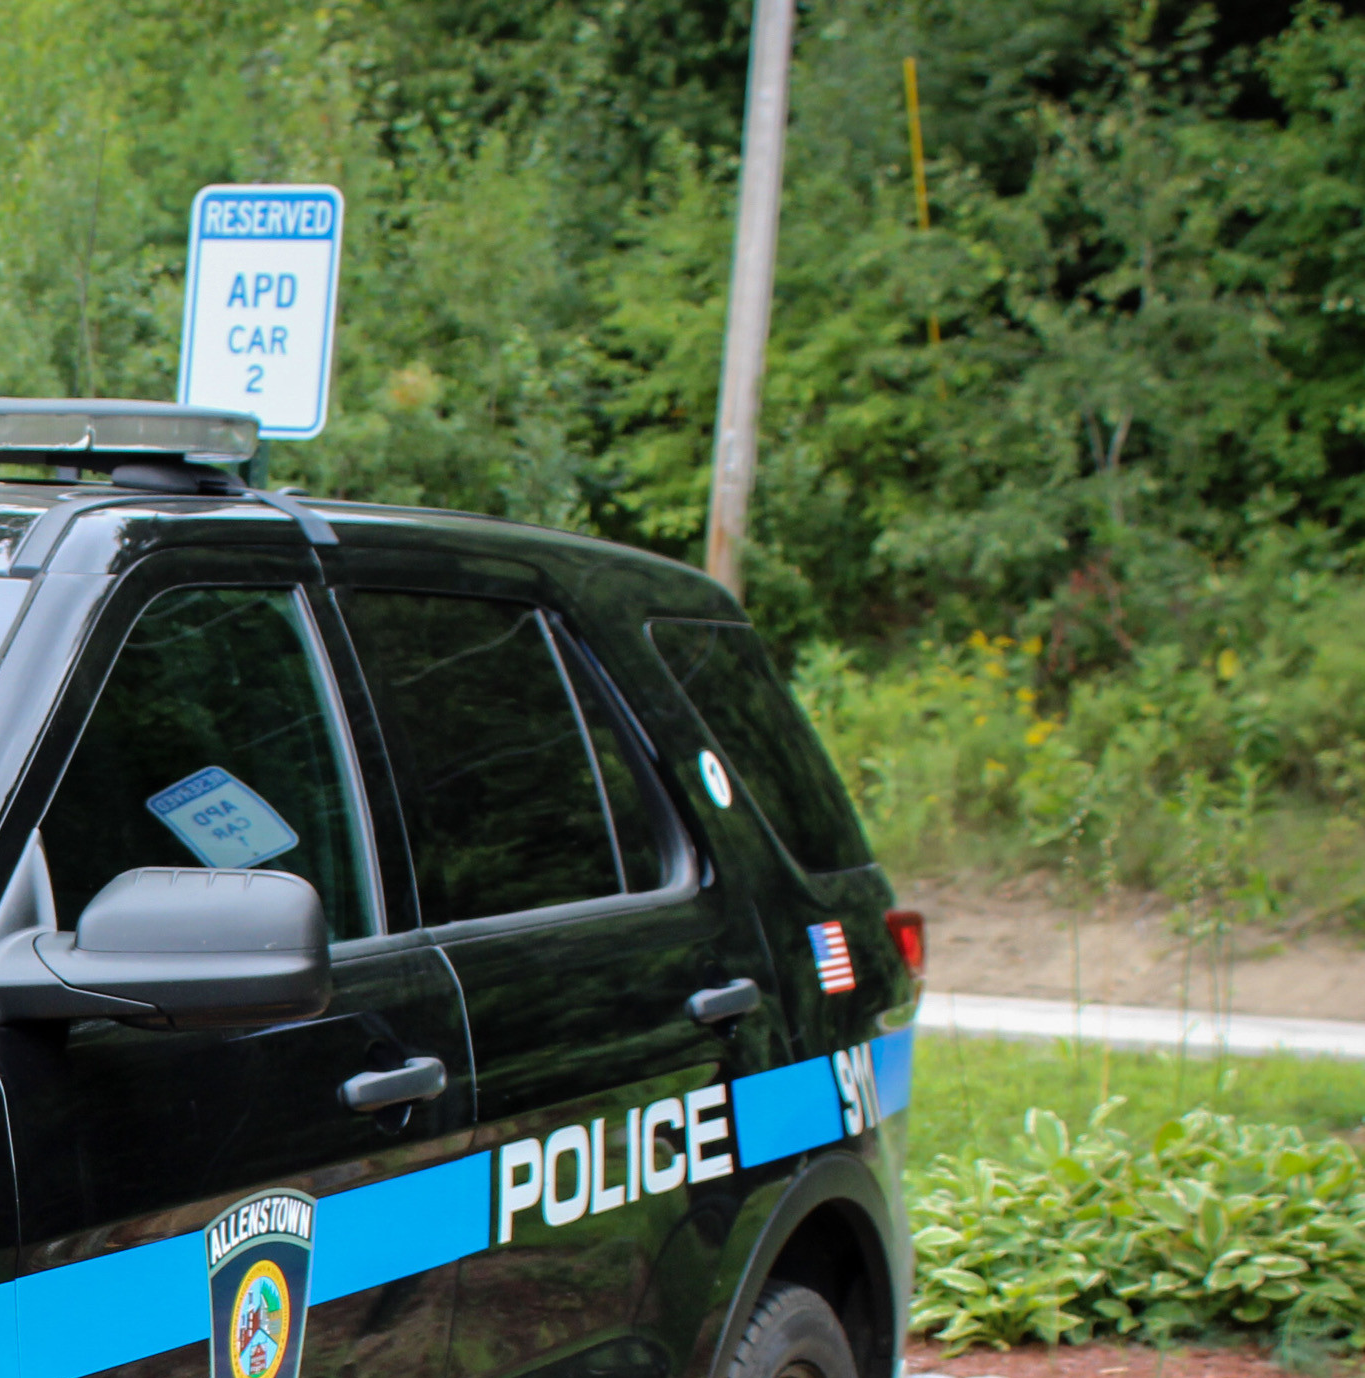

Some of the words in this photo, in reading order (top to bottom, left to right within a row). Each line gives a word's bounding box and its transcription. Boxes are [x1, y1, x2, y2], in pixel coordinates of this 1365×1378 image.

[205, 200, 333, 236] RESERVED
[227, 272, 297, 308] APD
[228, 325, 289, 354] CAR
[245, 364, 265, 393] 2
[832, 1042, 881, 1135] 911
[497, 1084, 734, 1244] POLICE
[210, 1196, 312, 1266] ALLENSTOWN
